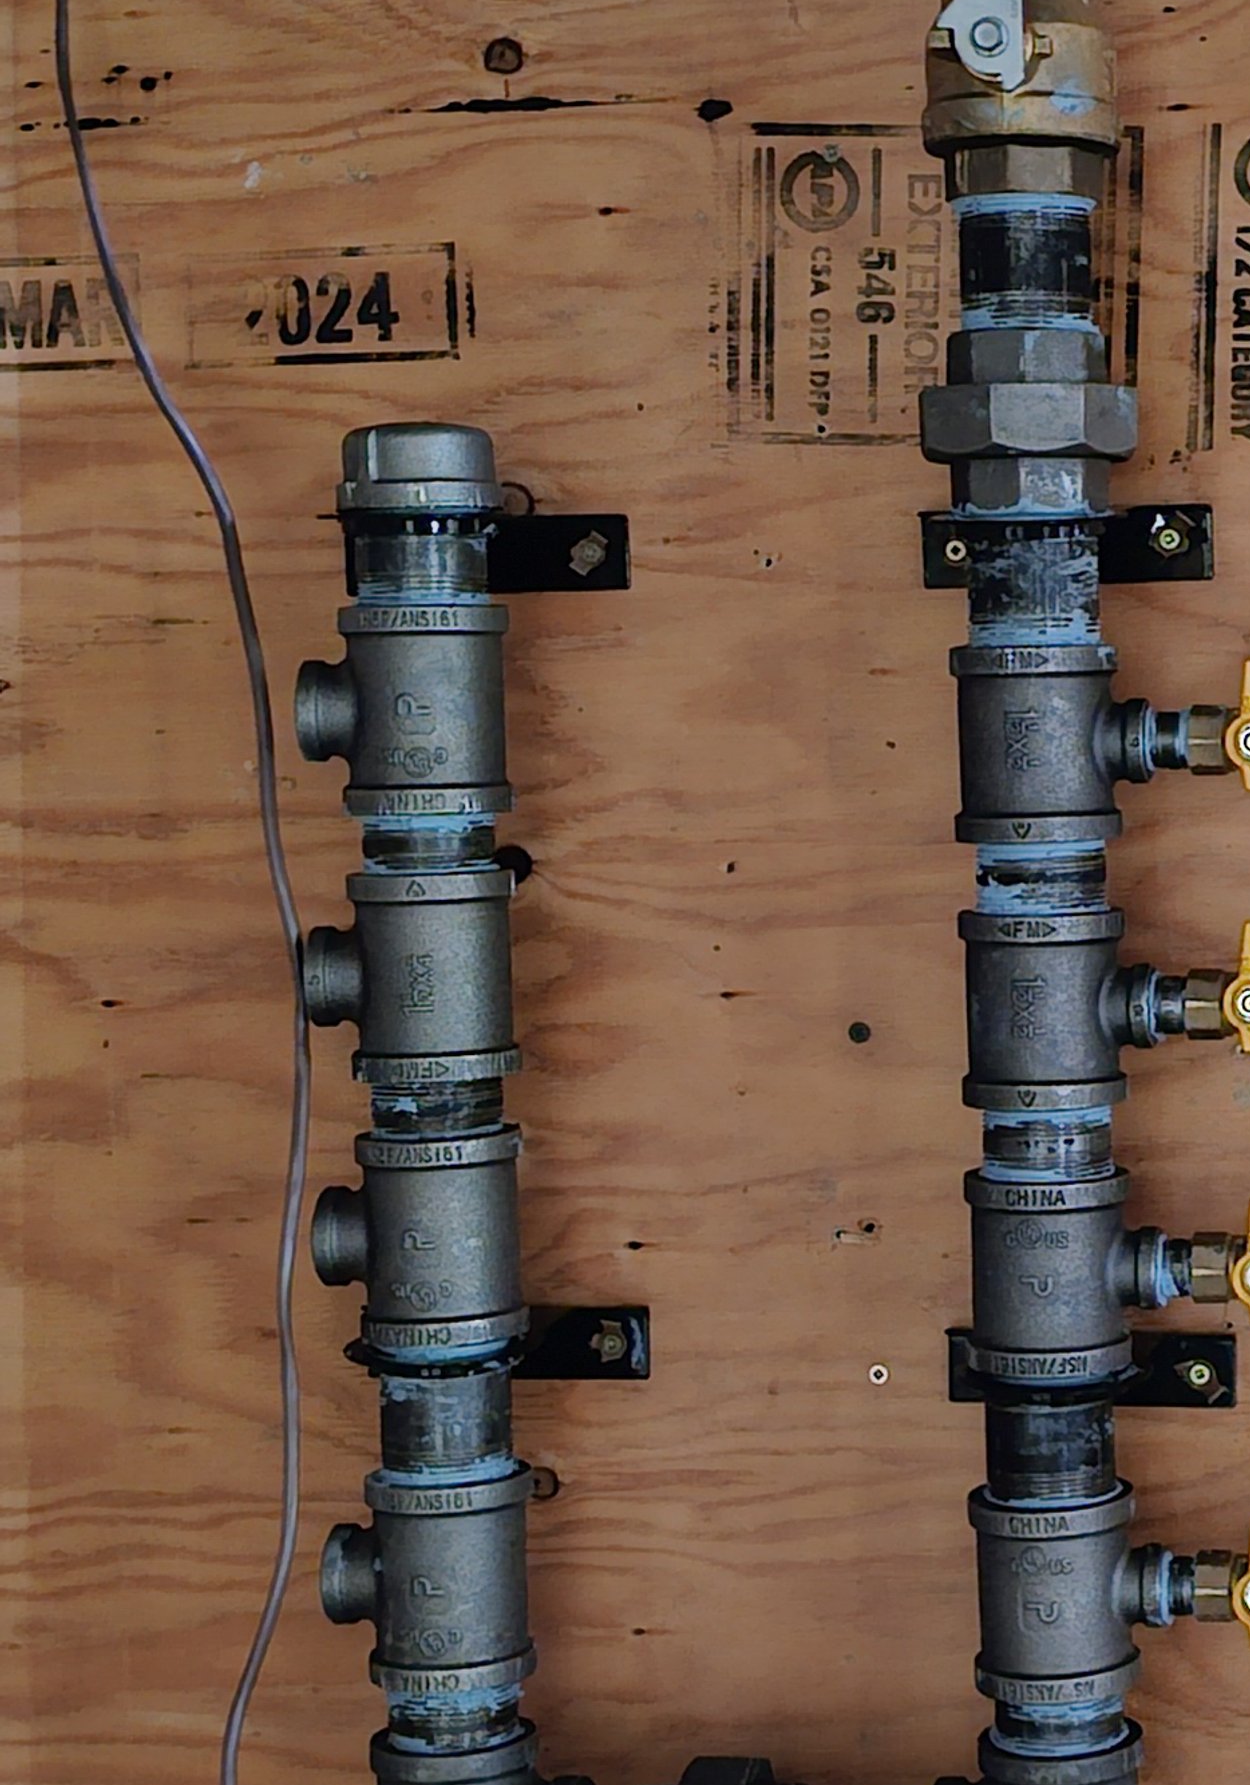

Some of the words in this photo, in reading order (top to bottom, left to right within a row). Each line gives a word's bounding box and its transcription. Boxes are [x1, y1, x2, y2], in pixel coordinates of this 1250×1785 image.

[809, 246, 833, 299] CSA
[856, 247, 897, 326] 546
[238, 272, 400, 347] 2024
[807, 369, 832, 418] DFP
[1004, 1187, 1067, 1209] CHINA
